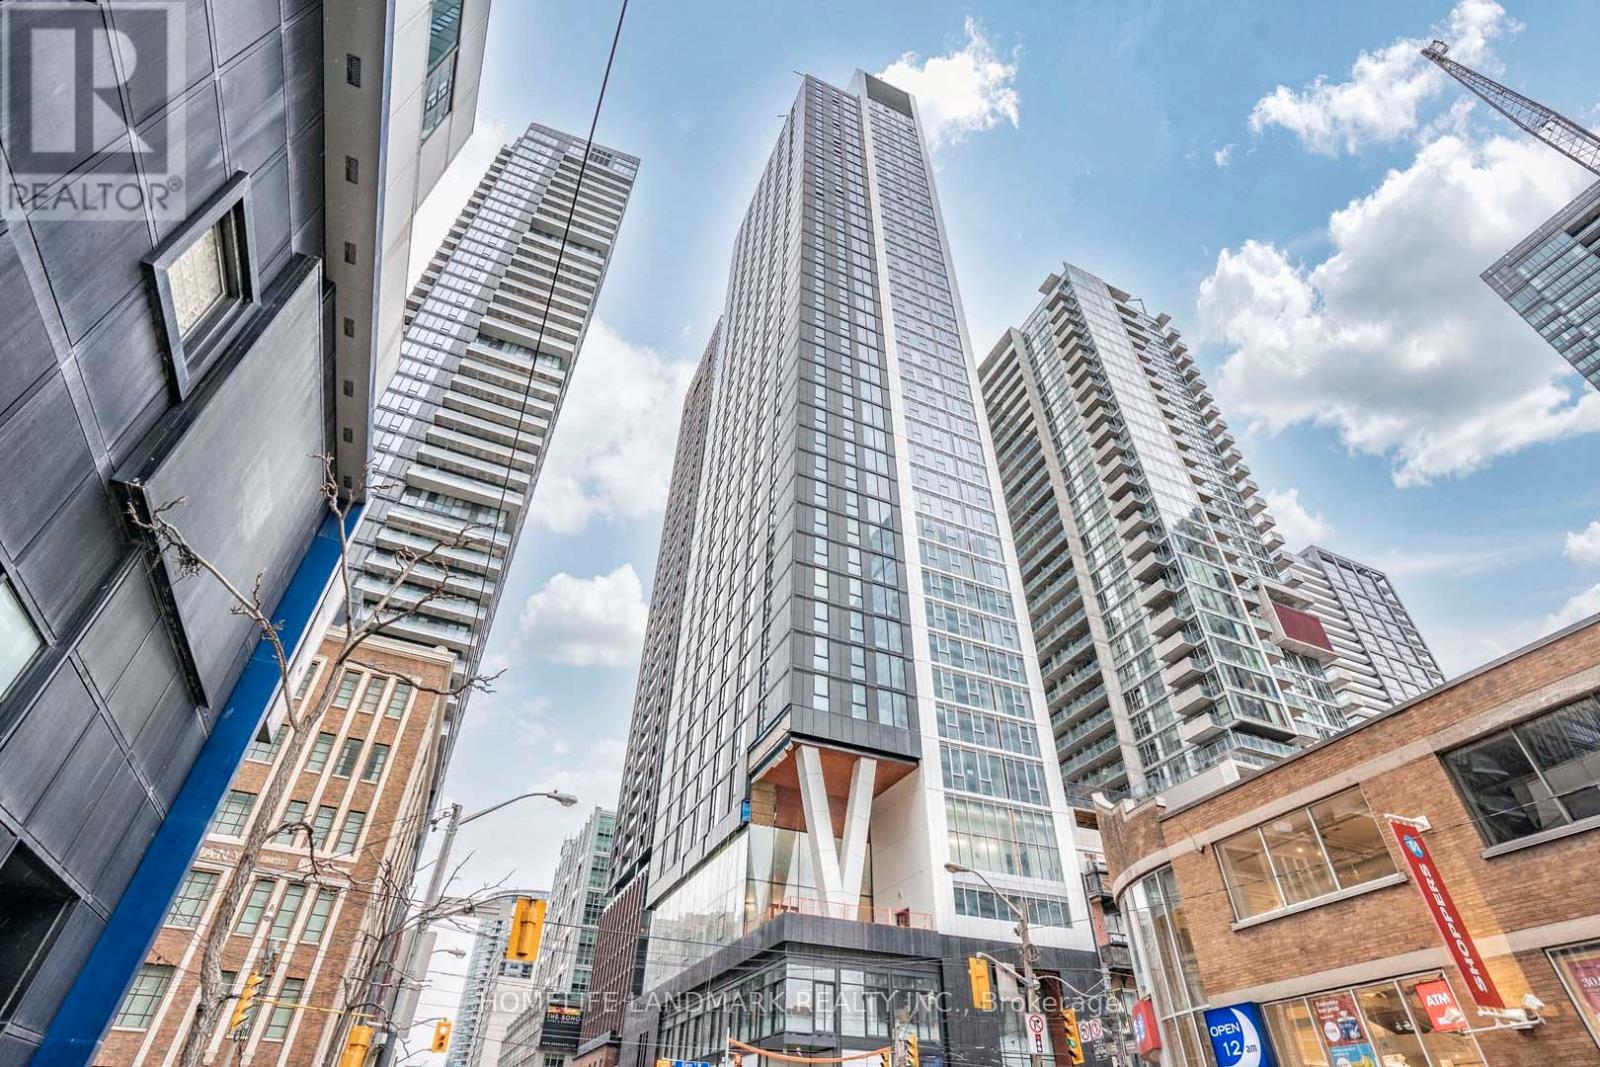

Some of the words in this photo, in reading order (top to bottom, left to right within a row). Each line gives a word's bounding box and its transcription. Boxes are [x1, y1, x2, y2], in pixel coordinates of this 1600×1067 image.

[1419, 863, 1488, 993] SHOPPERS
[1426, 992, 1451, 1007] ATM
[1210, 1021, 1241, 1037] OPEN
[1223, 1040, 1242, 1057] 12
[1245, 1043, 1258, 1054] am
